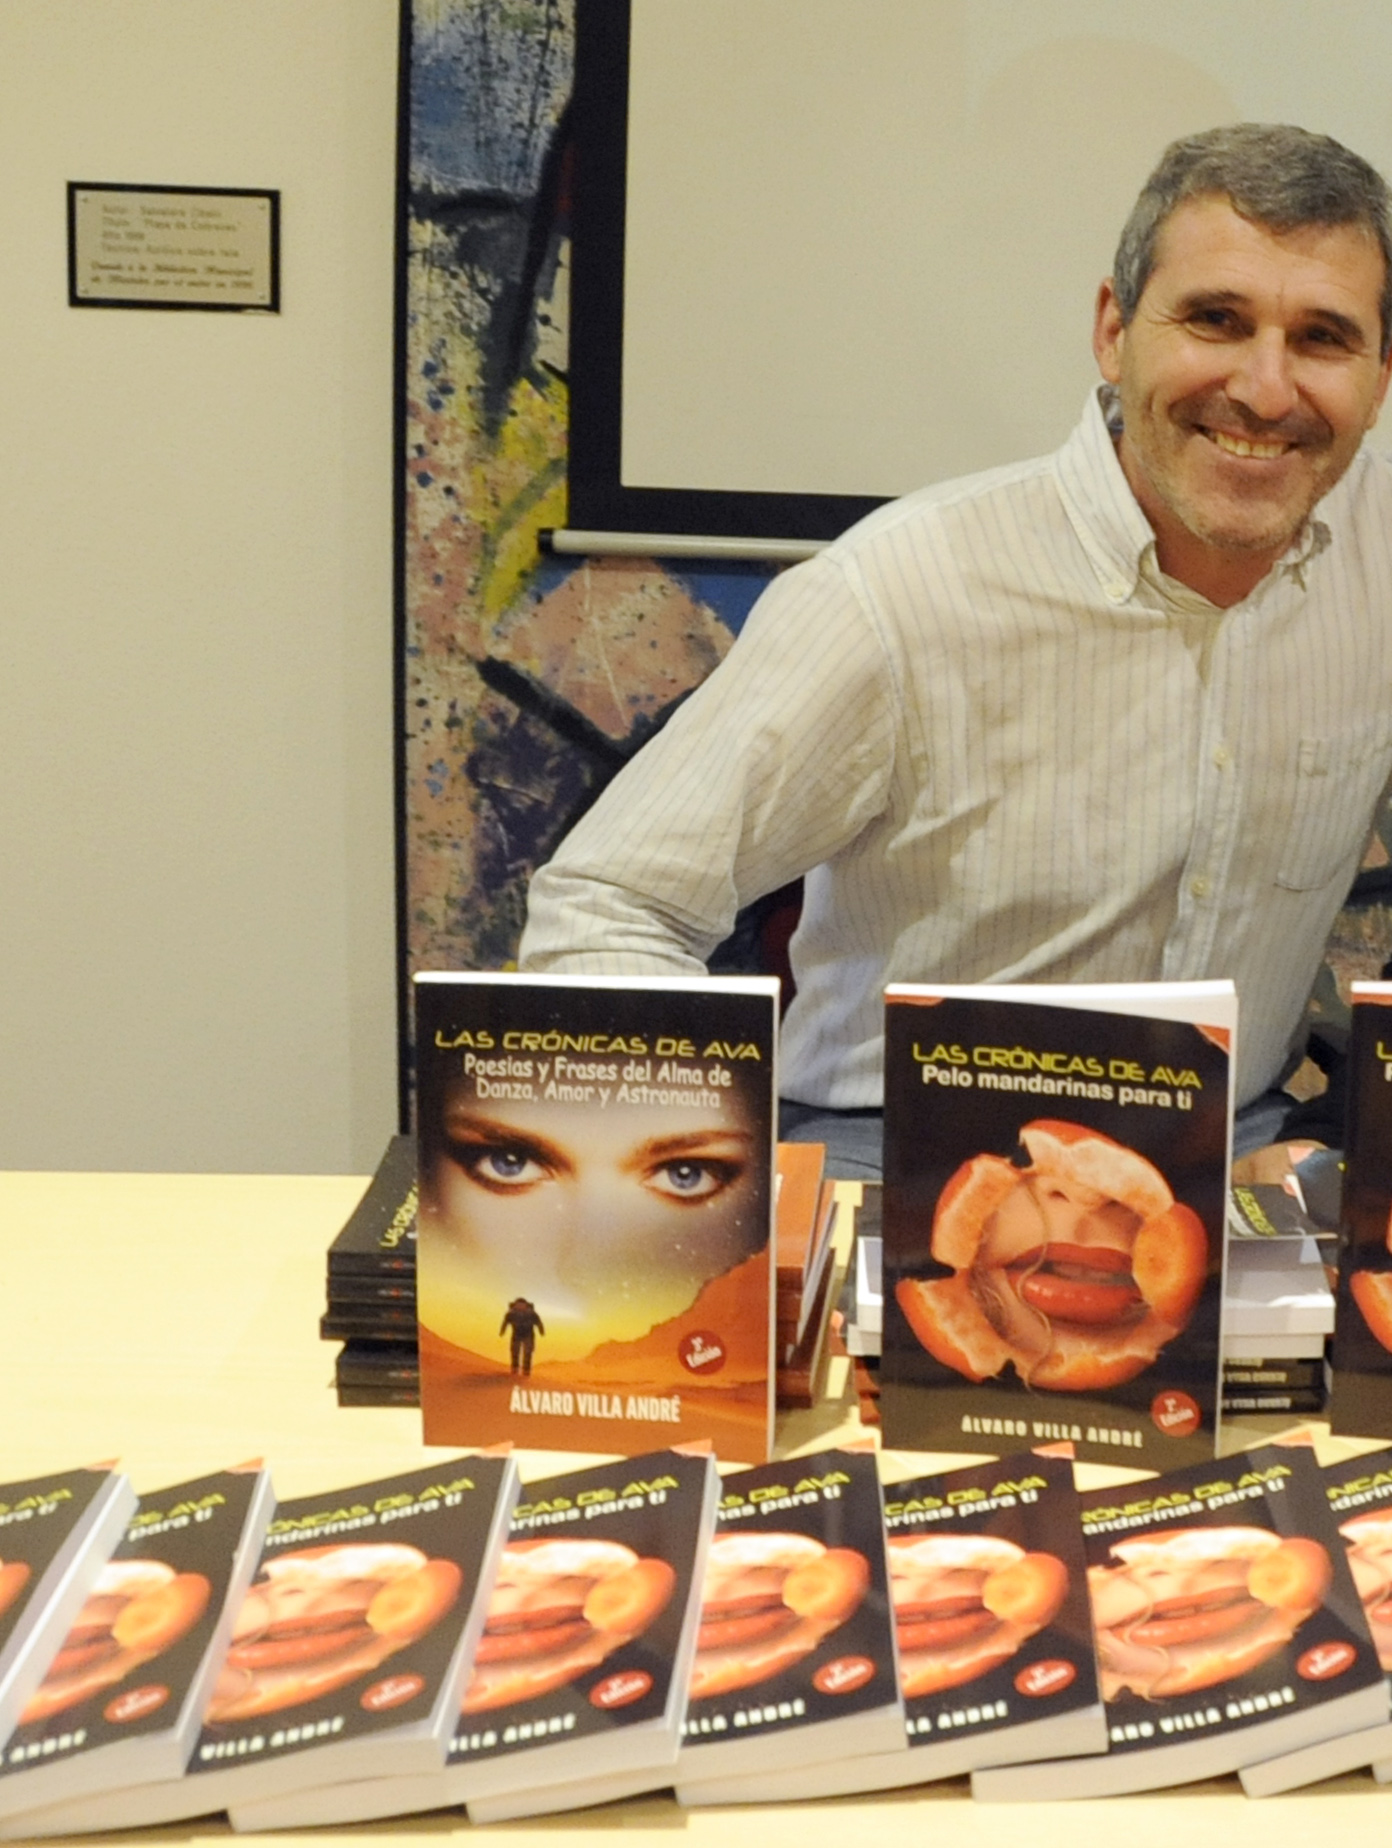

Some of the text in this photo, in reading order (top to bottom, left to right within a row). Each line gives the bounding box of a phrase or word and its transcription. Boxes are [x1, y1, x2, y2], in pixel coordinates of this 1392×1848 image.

[435, 1029, 761, 1061] LAS CRÓNICAS DE AVA
[537, 1061, 550, 1082] y
[554, 1056, 617, 1081] Frases
[623, 1060, 650, 1083] del
[656, 1063, 703, 1085] Alma
[708, 1065, 732, 1087] de
[912, 1042, 1202, 1090] LAS CRÓNICAS DE AVA
[476, 1077, 720, 1108] Danza, Amor y Astronauta
[922, 1065, 1193, 1110] Pelo mandarinas para ti
[510, 1385, 681, 1423] ÁLVARO VILLA ANDRÉ
[1032, 1421, 1082, 1441] VILLA
[373, 1493, 415, 1513] DE
[418, 1477, 475, 1501] AVA
[577, 1475, 680, 1506] DE AVA
[749, 1485, 789, 1503] DE
[794, 1471, 850, 1494] AVA
[947, 1475, 1048, 1506] DE AVA
[1193, 1481, 1233, 1500] DE
[1237, 1464, 1292, 1489] AVA
[14, 1488, 73, 1512] AVA
[167, 1492, 226, 1518] AVA
[585, 1496, 644, 1519] para
[649, 1489, 667, 1505] ti
[760, 1491, 819, 1515] para
[823, 1484, 841, 1500] ti
[958, 1494, 1016, 1518] para
[1019, 1488, 1038, 1503] ti
[1082, 1477, 1285, 1536] andarinas para ti
[128, 1506, 213, 1543] para ti
[265, 1492, 463, 1546] ndarinas para ti
[1111, 1721, 1154, 1742] ARO
[1159, 1707, 1222, 1734] VILLA
